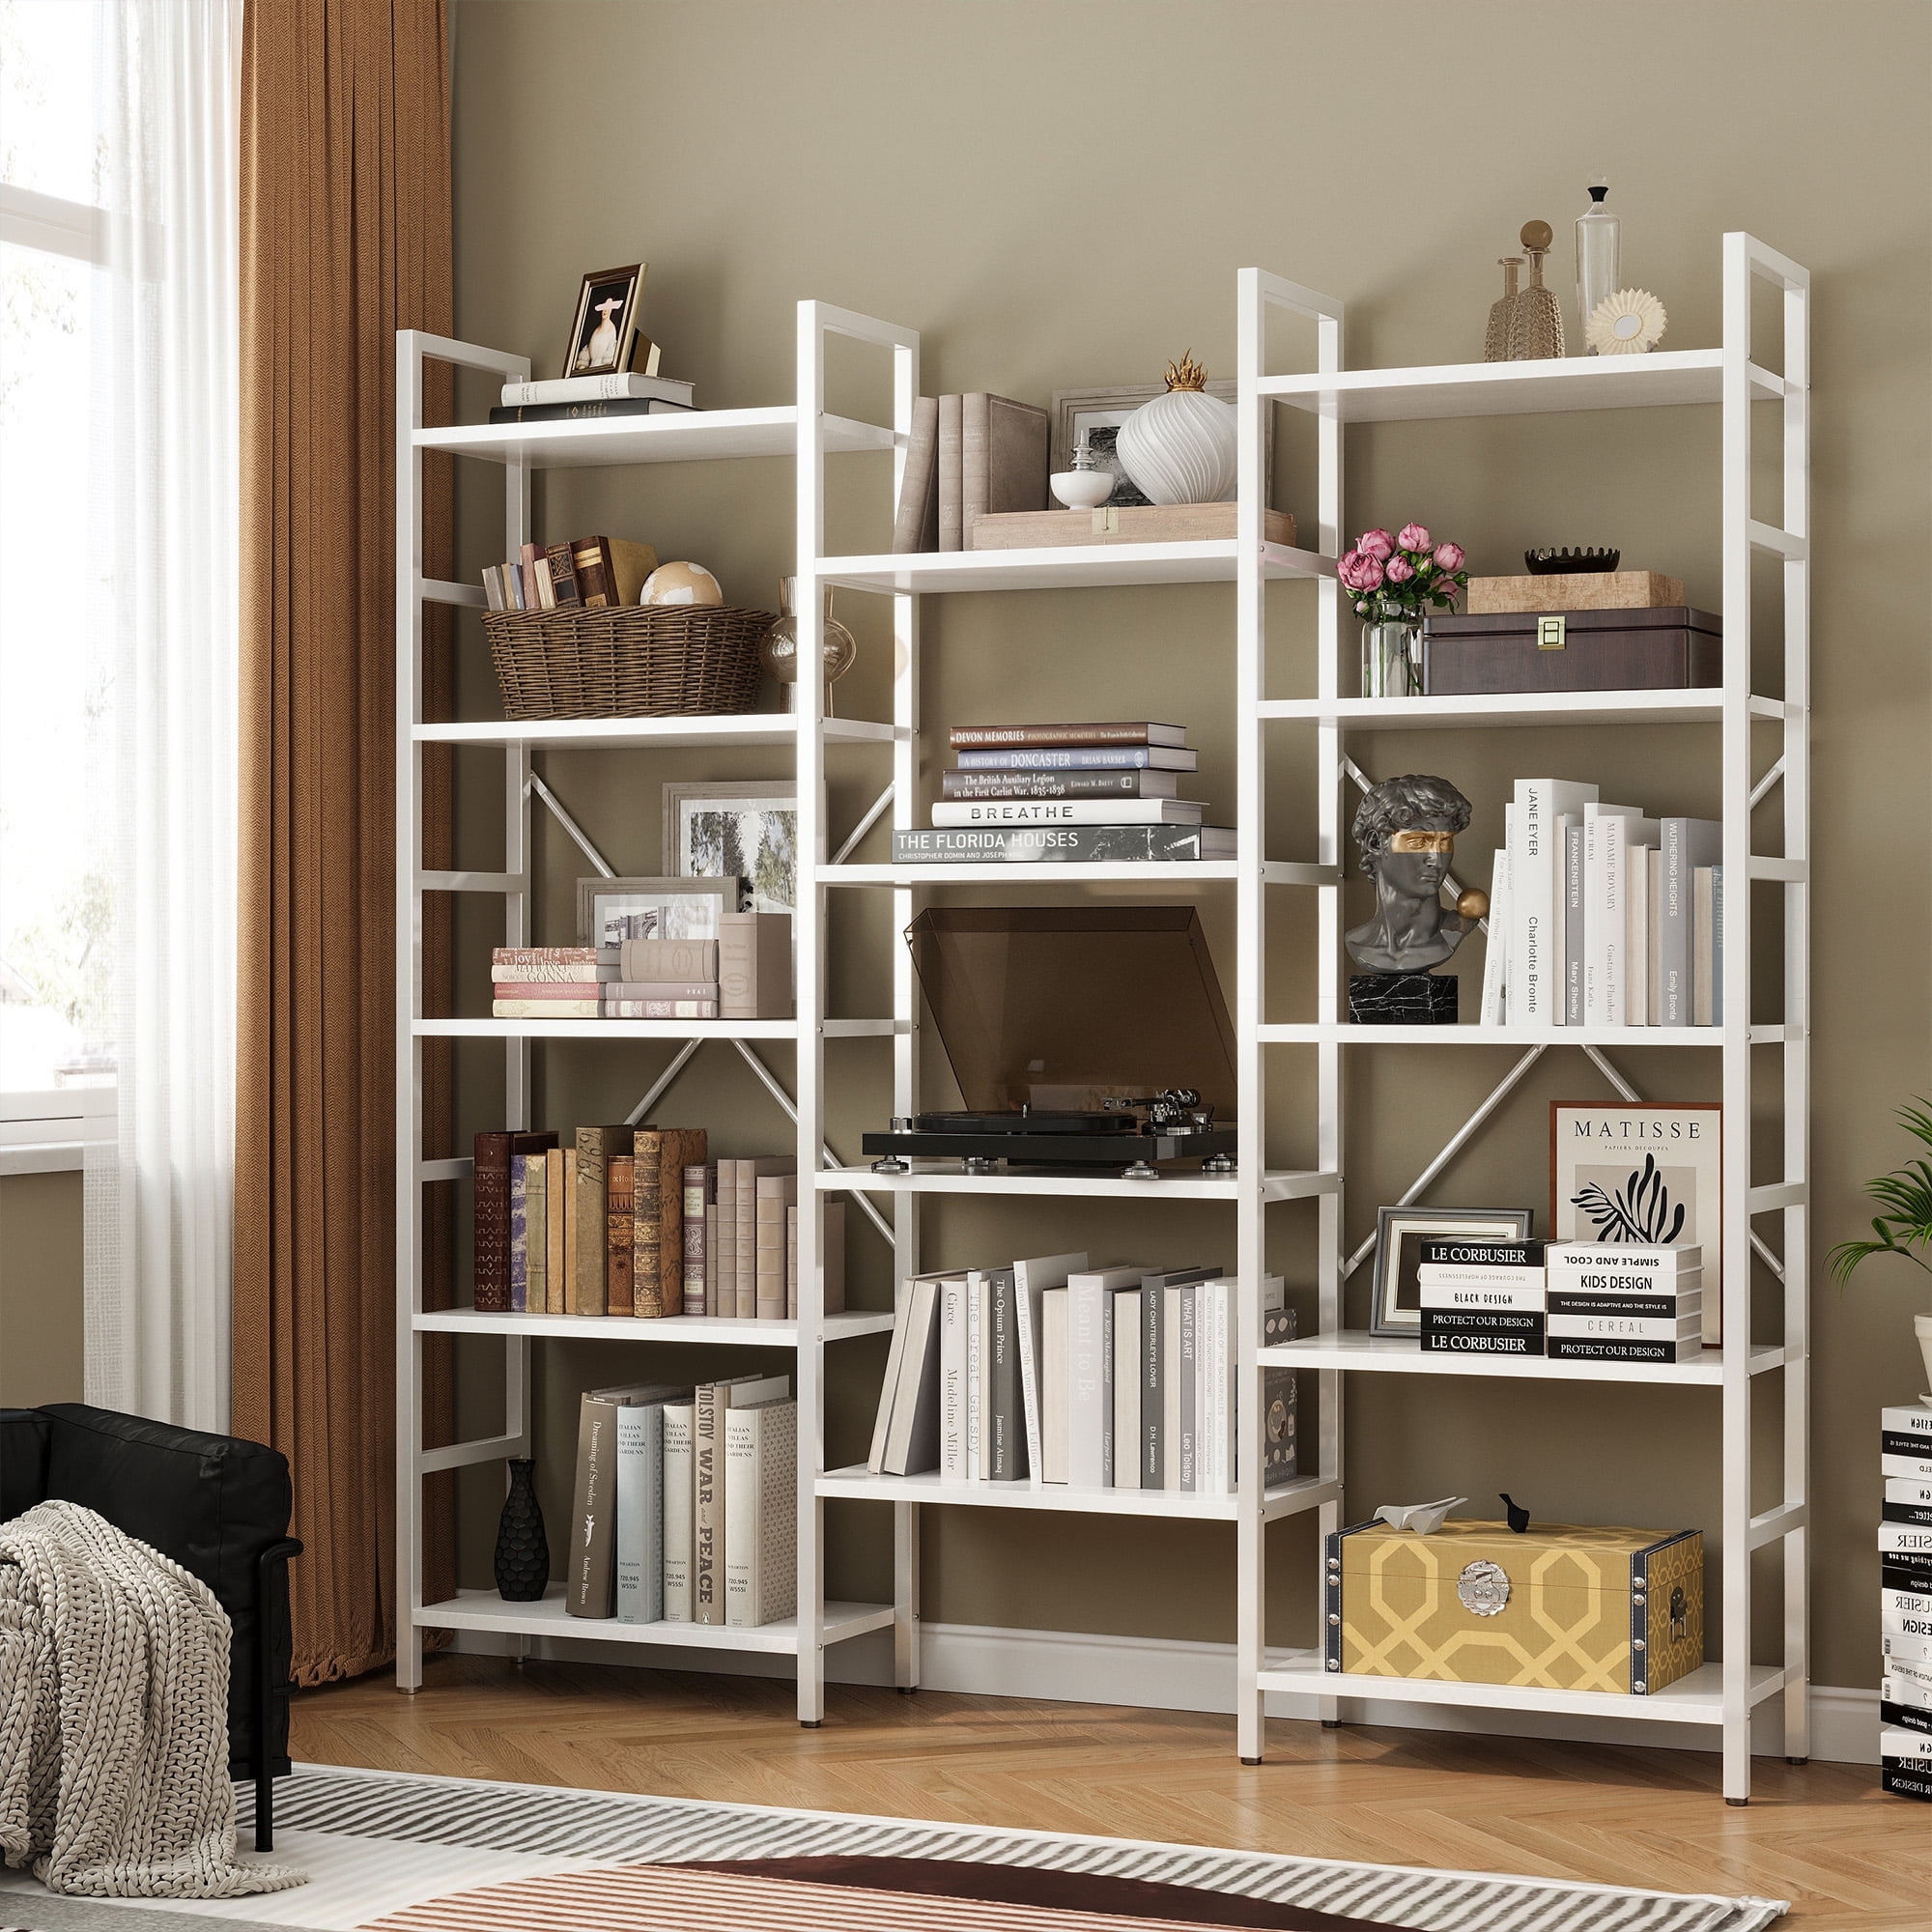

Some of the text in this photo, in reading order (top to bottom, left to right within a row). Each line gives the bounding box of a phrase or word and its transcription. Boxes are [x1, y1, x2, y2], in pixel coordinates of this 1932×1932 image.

[956, 730, 1025, 743] DEVON MEMORIES
[1010, 753, 1071, 767] DONCASTER
[953, 788, 962, 797] in
[962, 787, 974, 797] the
[1030, 783, 1065, 797] 1835-1838
[964, 772, 1055, 786] The British Auxiliary Legion
[971, 806, 1074, 820] BREATHE
[1528, 787, 1539, 857] JANE EYER
[897, 831, 1080, 850] THE FLORIDA HOUSES
[898, 852, 943, 861] CHRISTOPHER
[944, 851, 966, 860] DOMIN
[981, 850, 1008, 859] JOSEPH
[1669, 821, 1678, 917] WUTHERING HEIGHTS
[514, 953, 532, 966] joy
[1528, 917, 1538, 1013] Charlotte Bronte
[1570, 961, 1578, 983] Mary
[1667, 970, 1678, 1020] Emily Bronte
[1574, 1121, 1701, 1139] MATISSE
[1431, 1247, 1527, 1263] LE CORBUSIER
[1563, 1256, 1661, 1267] SIMPLE AND COOL
[1016, 1274, 1027, 1311] Animal
[1580, 1275, 1653, 1290] KIDS DESIGN
[947, 1293, 958, 1325] Circe
[1454, 1293, 1515, 1305] BLACK DESIGN
[995, 1279, 1006, 1364] The Opium Prince
[1183, 1297, 1193, 1360] WHAT IS ART
[1433, 1315, 1534, 1327] PROTECT OUR DESIGN
[1587, 1320, 1644, 1334] CEREAL
[1078, 1284, 1095, 1402] Meant to Be
[1431, 1335, 1527, 1351] LE CORBUSIER
[1560, 1344, 1665, 1357] PROTECT OUR DESIGN
[967, 1293, 980, 1456] The Great Gatsby
[697, 1385, 715, 1440] TOLSTOY
[947, 1369, 958, 1470] Madeline Miller
[589, 1420, 602, 1462] Dreaming
[995, 1414, 1004, 1446] Jasmine
[1182, 1433, 1193, 1484] Leo Tolstoy
[698, 1447, 713, 1505] WAR
[587, 1474, 598, 1506] Sweden
[582, 1555, 591, 1582] Andrew
[698, 1526, 714, 1605] PEACE
